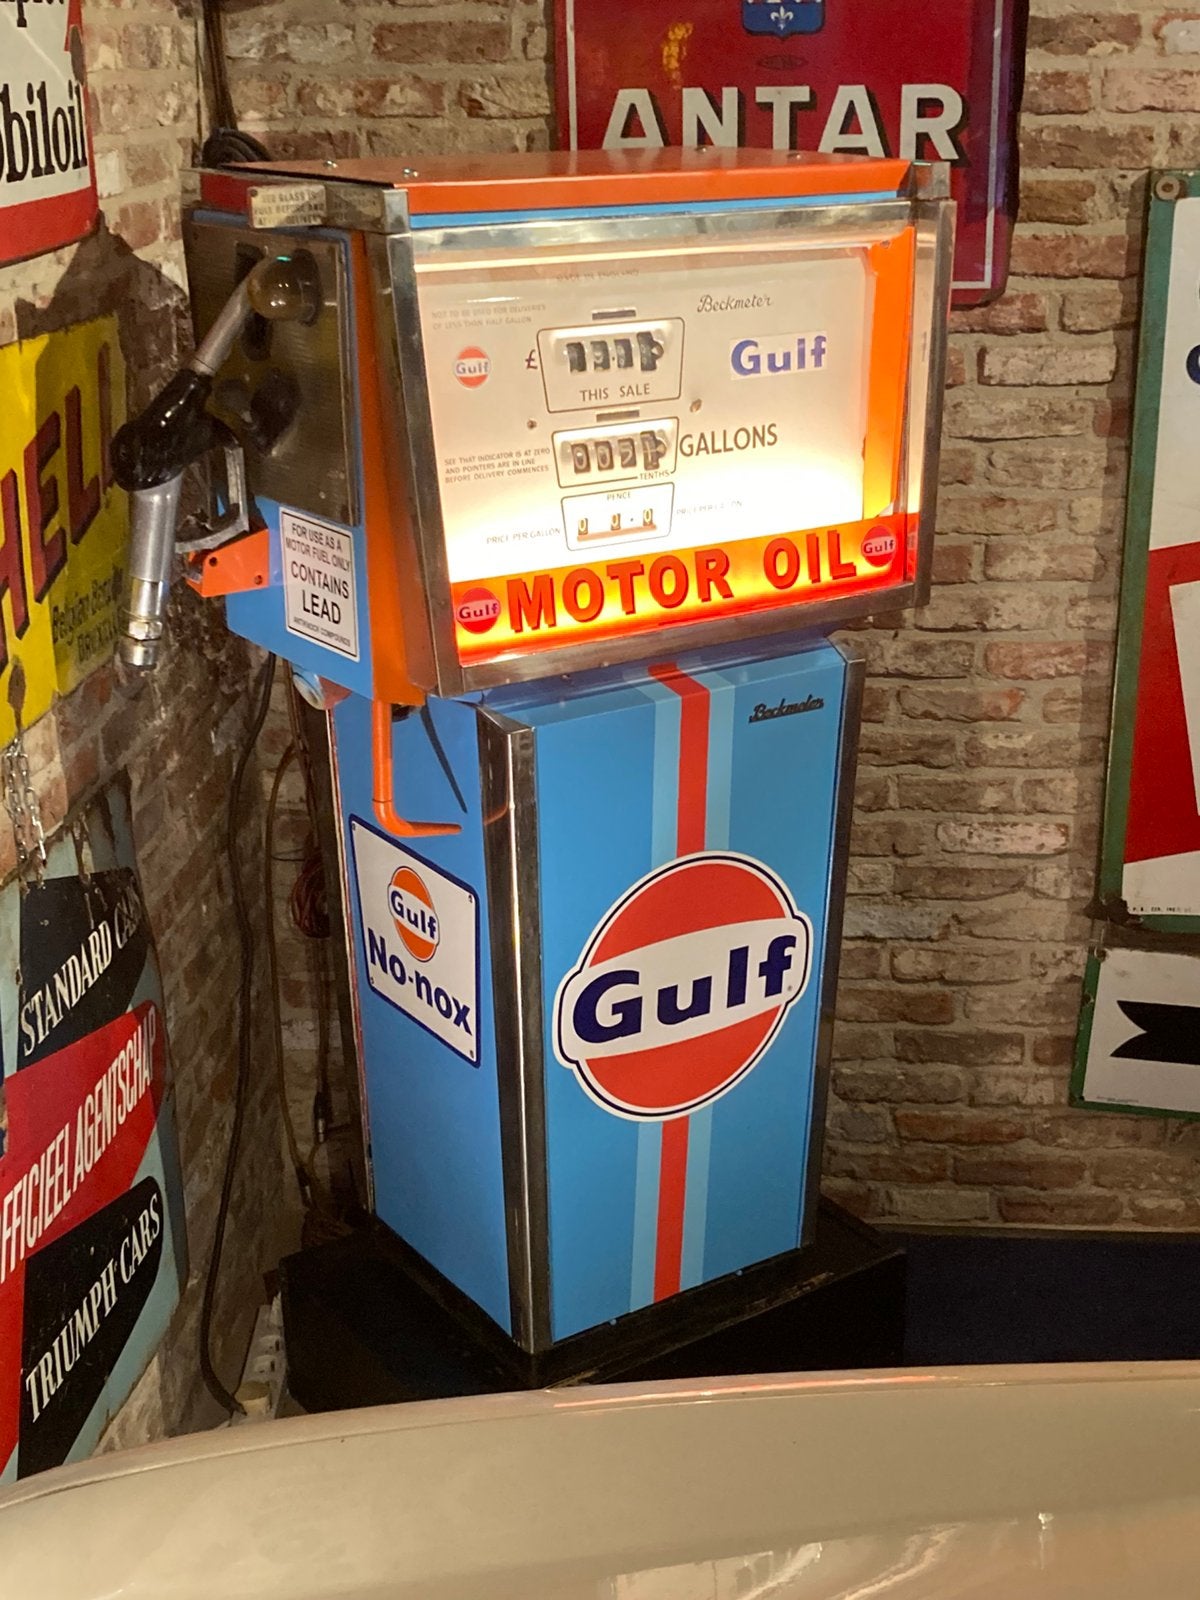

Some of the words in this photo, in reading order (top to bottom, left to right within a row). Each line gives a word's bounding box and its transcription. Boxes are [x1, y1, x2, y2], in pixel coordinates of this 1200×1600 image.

[0, 79, 88, 183] biloil
[602, 84, 966, 160] ANTAR
[697, 294, 774, 313] Beckmeter
[456, 361, 490, 375] Gulf
[730, 335, 827, 376] Gulf
[580, 387, 609, 402] THIS
[619, 383, 651, 398] SALE
[444, 458, 456, 466] SEE
[459, 455, 476, 464] THAT
[477, 451, 513, 461] INDICATOR
[515, 450, 522, 458] IS
[534, 447, 551, 456] ZERO
[679, 423, 778, 457] GALLONS
[445, 474, 471, 484] BEFORE
[473, 470, 505, 480] DELIVERY
[507, 464, 550, 476] COMMENCES
[462, 462, 496, 472] POINTERS
[512, 459, 520, 467] IN
[521, 457, 536, 465] LINE
[639, 470, 670, 480] TENTHS
[607, 491, 631, 501] PENCE
[285, 537, 311, 555] MOTOR
[313, 546, 330, 565] FUEL
[332, 554, 350, 571] ONLY
[292, 523, 307, 538] FOR
[309, 528, 324, 545] USE
[325, 534, 335, 549] AS
[336, 538, 342, 551] A
[863, 540, 895, 554] Gulf
[291, 561, 349, 599] CONTAINS
[506, 549, 734, 633] MOTOR
[763, 529, 857, 590] OIL
[302, 589, 342, 625] LEAD
[458, 602, 498, 619] Gulf
[391, 890, 437, 939] Gulf
[20, 920, 112, 1057] STANDARD
[368, 928, 473, 1036] No-nox
[572, 934, 797, 1043] Gulf
[0, 1121, 72, 1285] FFICIEEL
[72, 1004, 157, 1194] AGENTSCHAP
[26, 1258, 118, 1424] TRIUMPH
[120, 1193, 161, 1284] CARS
